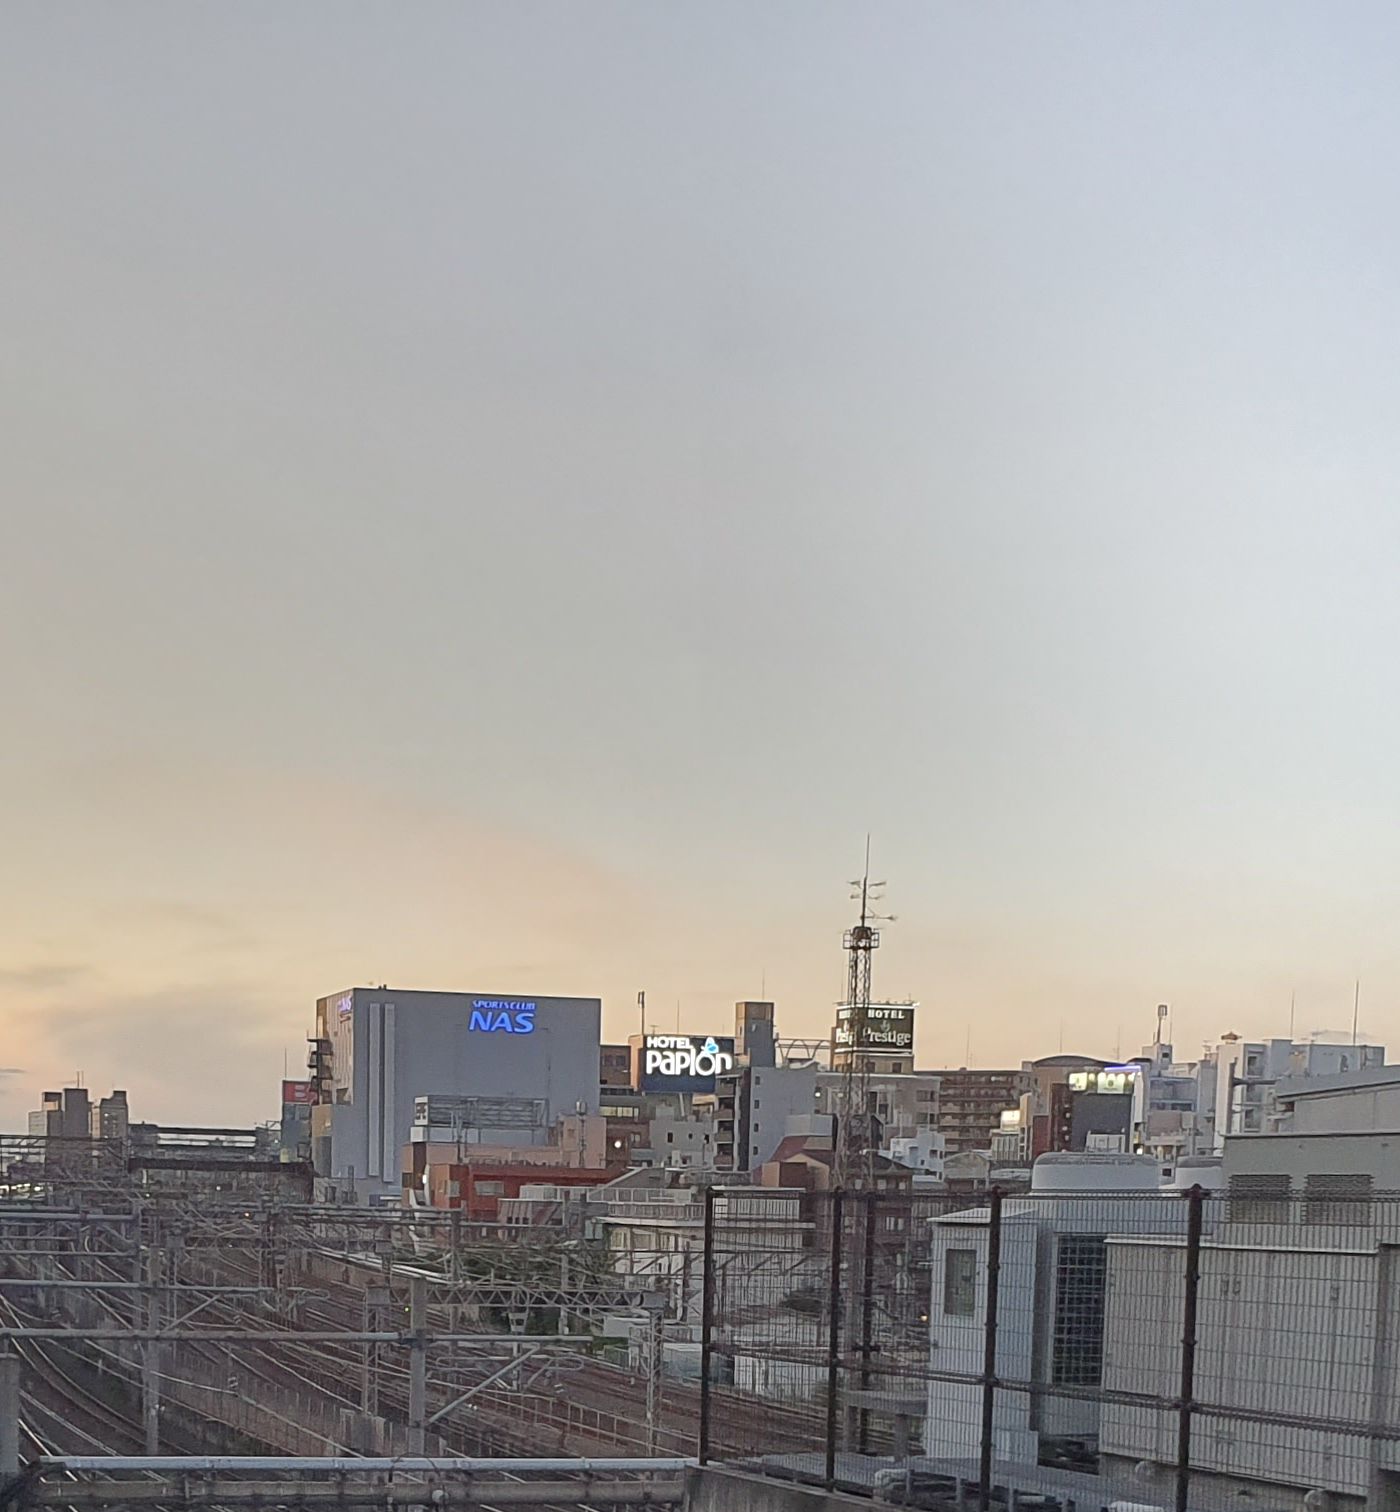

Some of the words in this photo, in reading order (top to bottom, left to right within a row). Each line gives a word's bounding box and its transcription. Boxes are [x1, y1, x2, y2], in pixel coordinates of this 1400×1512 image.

[867, 1009, 905, 1019] HOTEL
[469, 1010, 534, 1033] NAS
[646, 1036, 694, 1049] HOTEL
